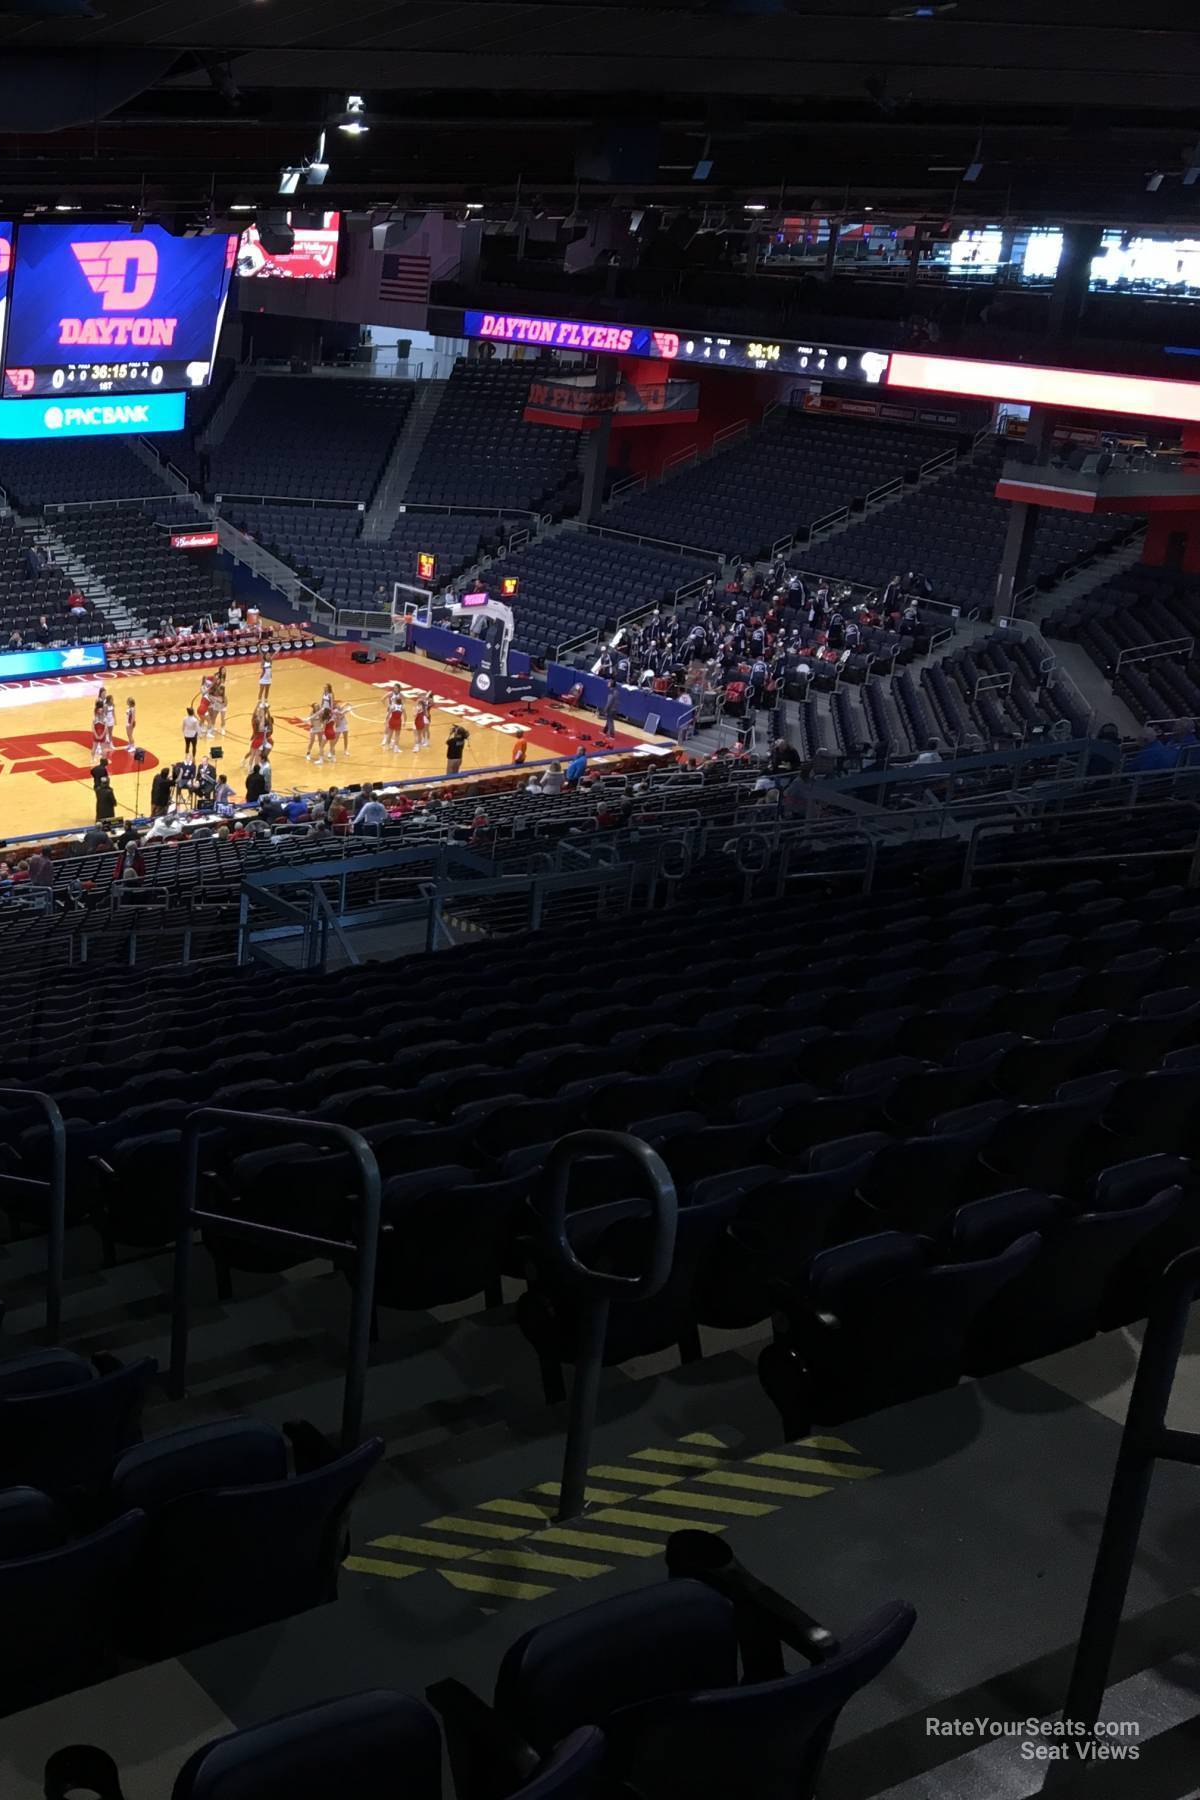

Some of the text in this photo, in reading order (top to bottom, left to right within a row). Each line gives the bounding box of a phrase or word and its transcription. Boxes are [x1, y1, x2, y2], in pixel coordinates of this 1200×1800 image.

[59, 317, 177, 346] DAYTON
[480, 315, 633, 351] DAYTON FLYERS
[719, 348, 726, 359] 0
[747, 343, 780, 360] 36:14
[800, 357, 808, 368] 0
[52, 369, 64, 388] 0
[68, 370, 87, 381] 4 0
[91, 364, 127, 379] 36:15
[130, 367, 148, 379] 0 4
[151, 366, 163, 384] 0
[103, 406, 149, 425] BANK
[0, 668, 145, 692] DAYTON
